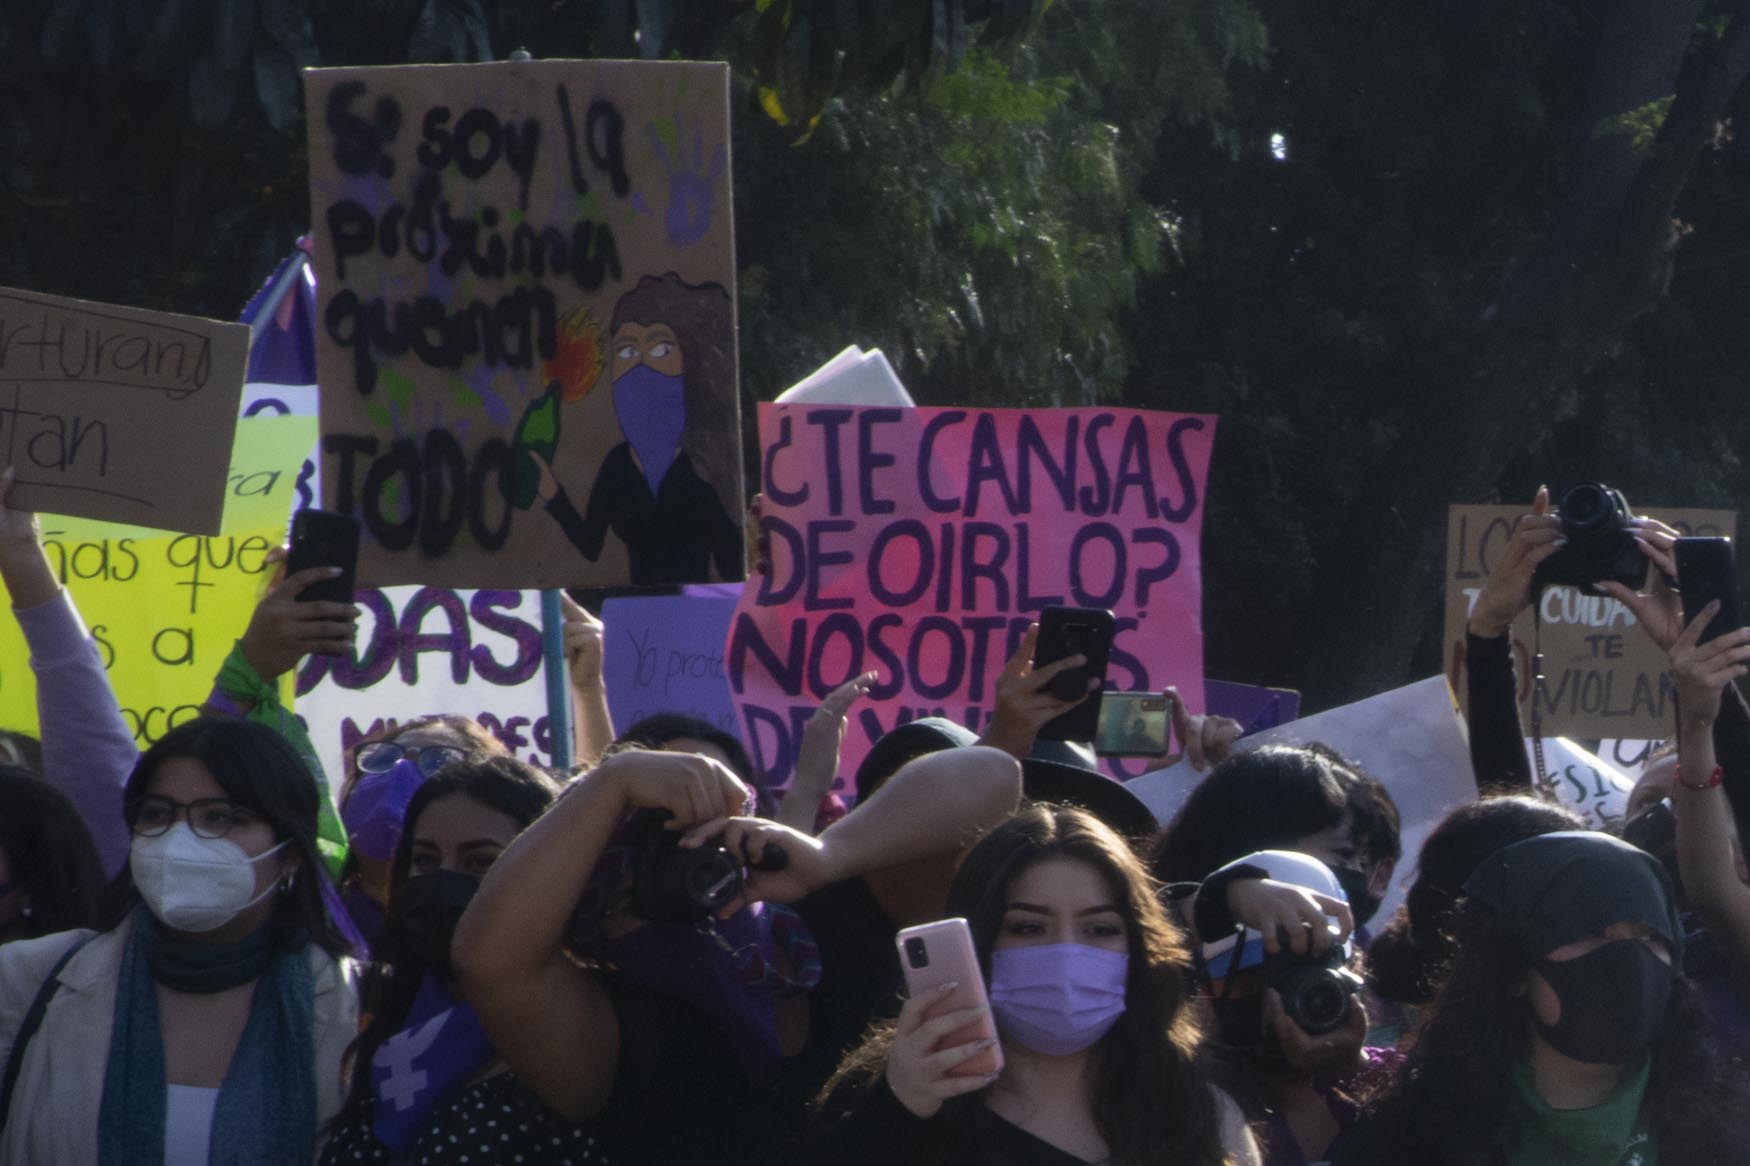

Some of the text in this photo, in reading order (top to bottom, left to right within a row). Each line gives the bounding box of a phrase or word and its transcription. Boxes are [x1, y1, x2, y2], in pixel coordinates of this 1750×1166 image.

[916, 410, 1206, 524] CANSAS
[754, 516, 857, 612] DE
[727, 611, 1150, 702] NOSOTS
